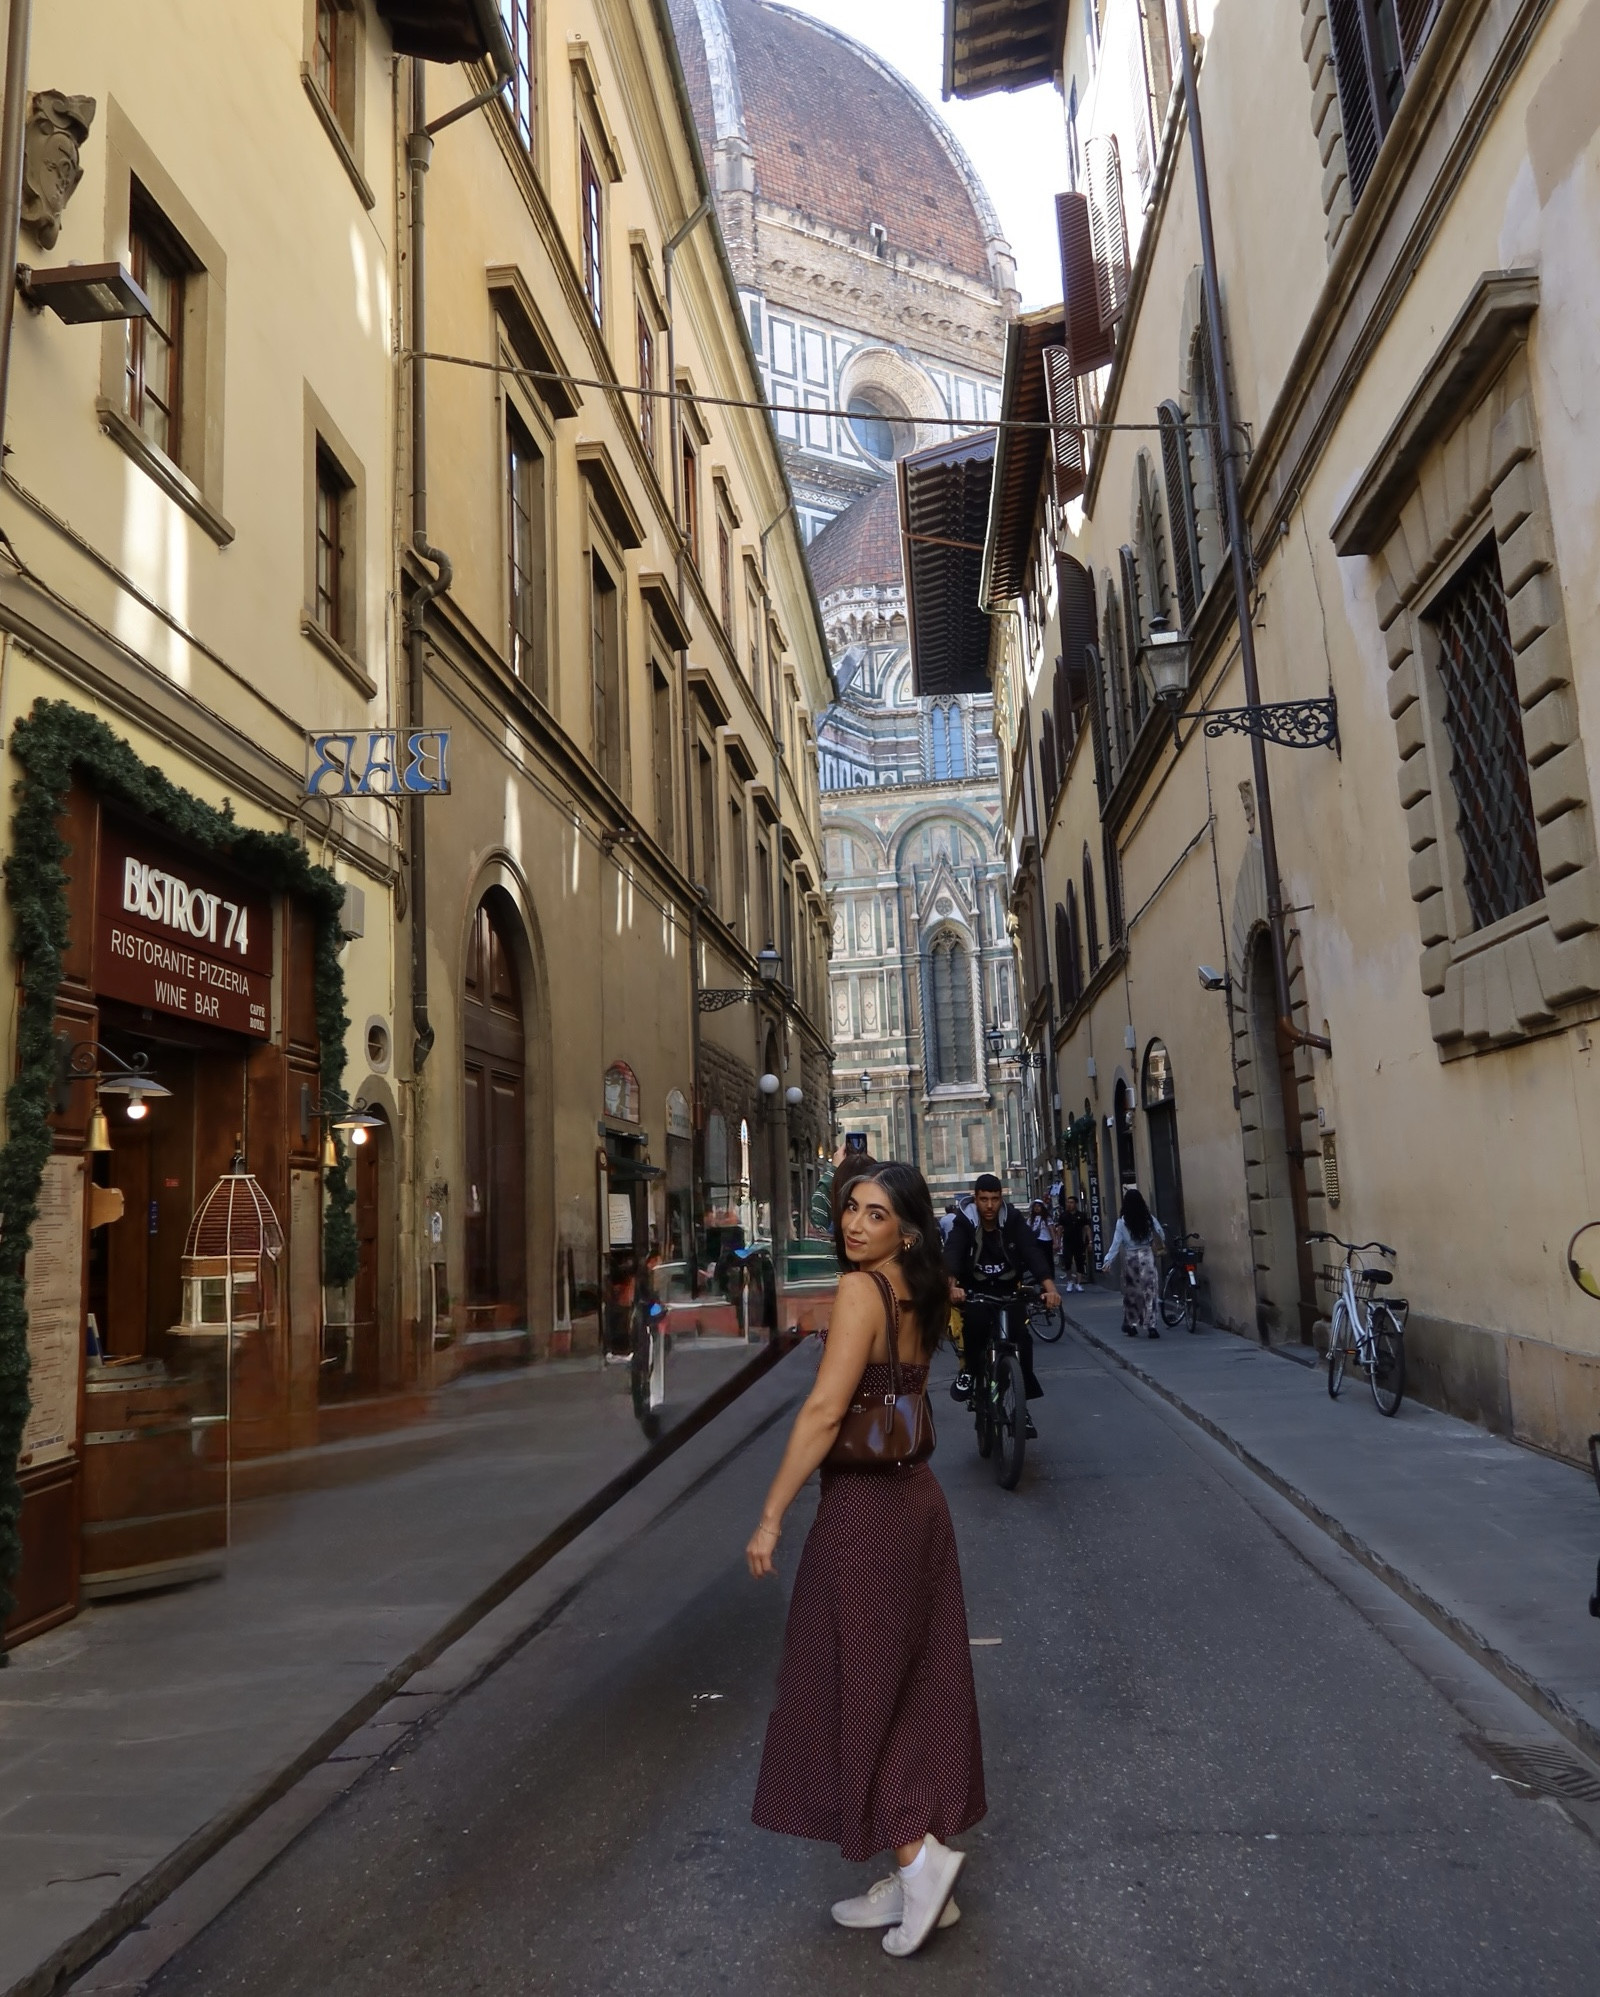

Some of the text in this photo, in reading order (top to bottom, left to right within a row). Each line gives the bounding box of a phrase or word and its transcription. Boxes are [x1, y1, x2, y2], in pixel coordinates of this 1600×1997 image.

[123, 856, 248, 955] BISTROT 74
[111, 929, 250, 997] RISTORANTE PIZZERIA
[154, 979, 220, 1019] WINE BAR
[1090, 1177, 1102, 1270] RISTORANTE
